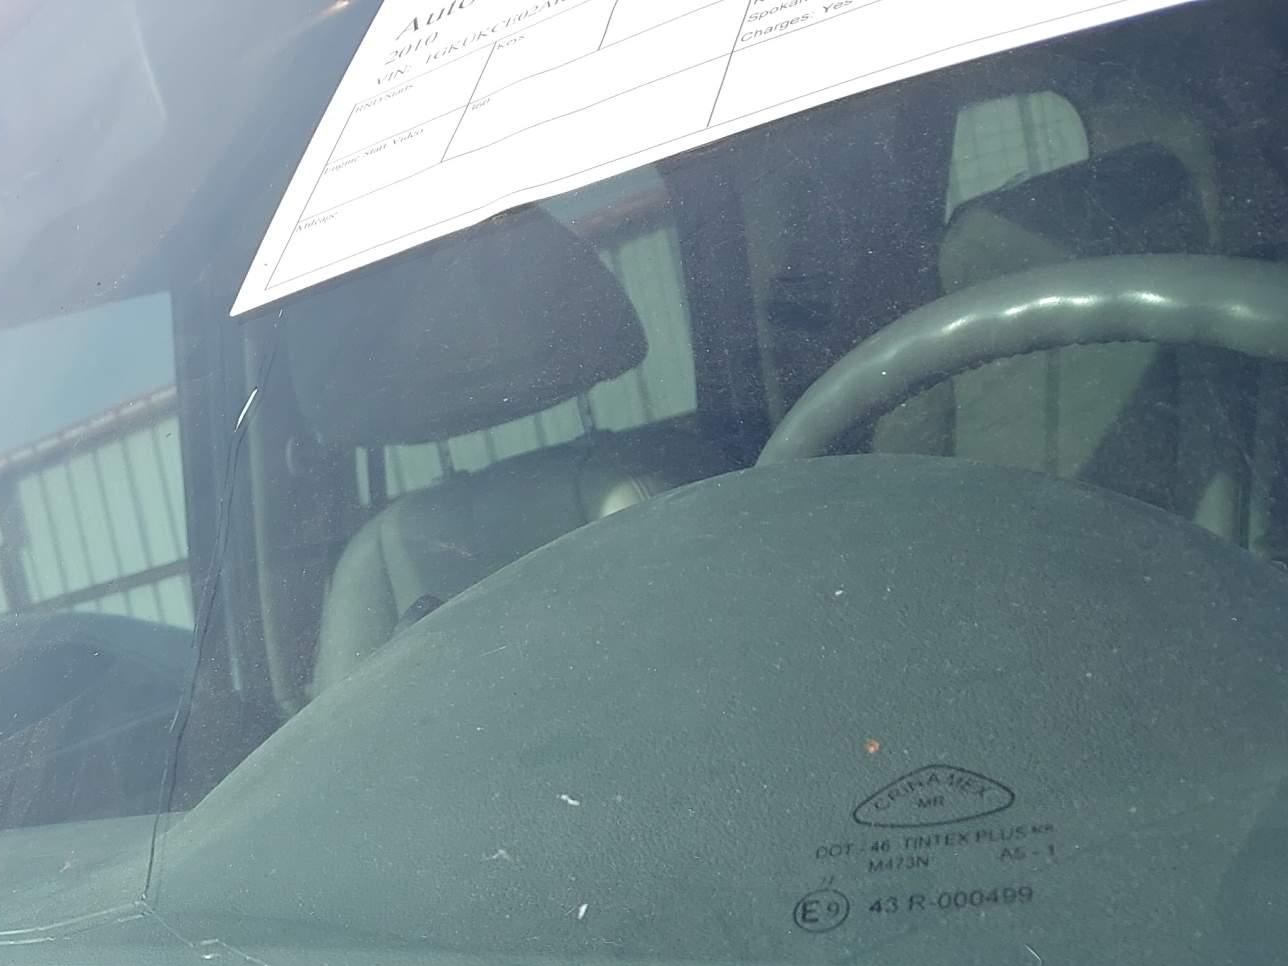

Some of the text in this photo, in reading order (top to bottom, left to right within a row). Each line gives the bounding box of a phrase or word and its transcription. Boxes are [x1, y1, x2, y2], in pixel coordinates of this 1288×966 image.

[384, 31, 439, 65] 2010
[815, 843, 854, 860] DOT
[870, 839, 891, 853] 46
[904, 834, 966, 850] TINTEX
[974, 827, 1028, 845] PLUS
[868, 896, 899, 915] 43
